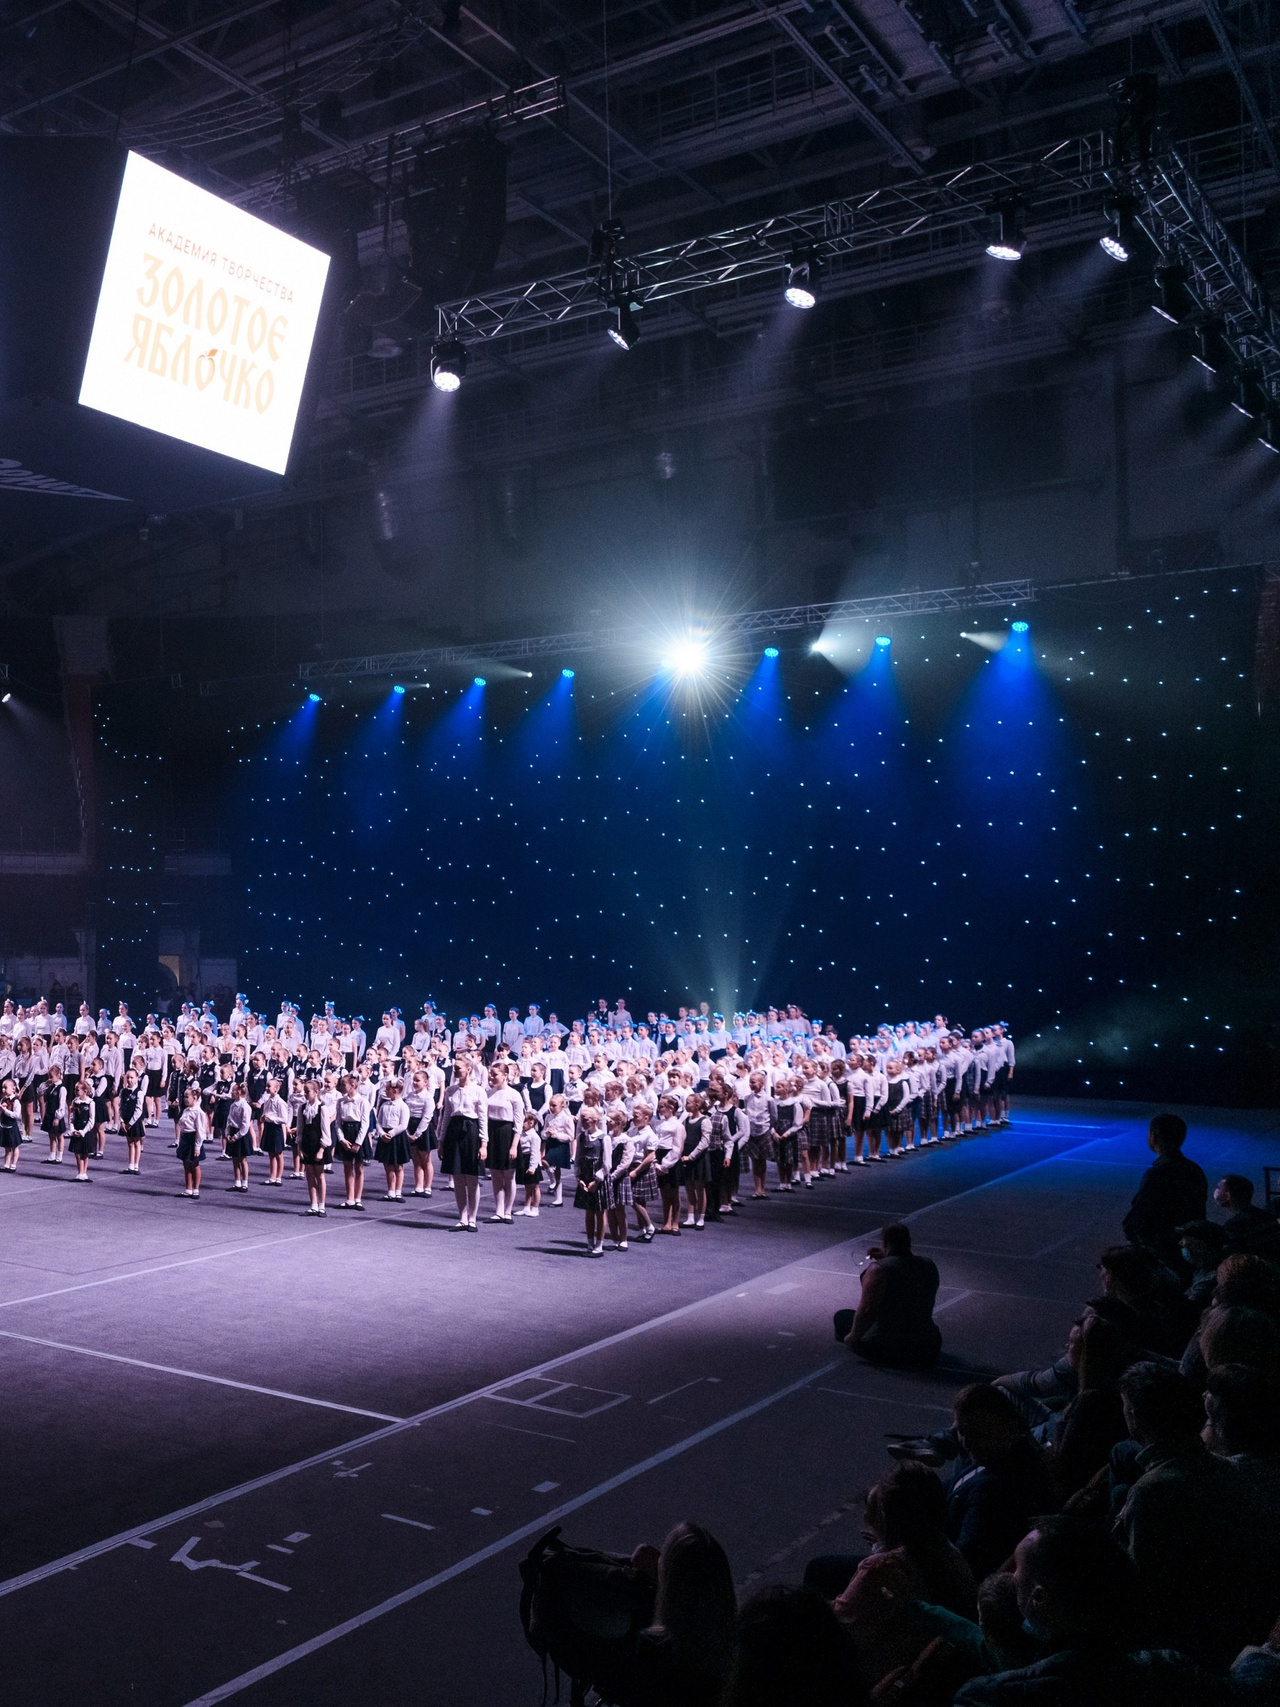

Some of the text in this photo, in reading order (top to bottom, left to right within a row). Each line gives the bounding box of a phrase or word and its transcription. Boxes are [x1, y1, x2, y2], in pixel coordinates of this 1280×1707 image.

[148, 223, 294, 303] АКАДЕМИЯ ТВОРЧЕСТВА
[122, 312, 275, 416] ЯБЛОЧКО
